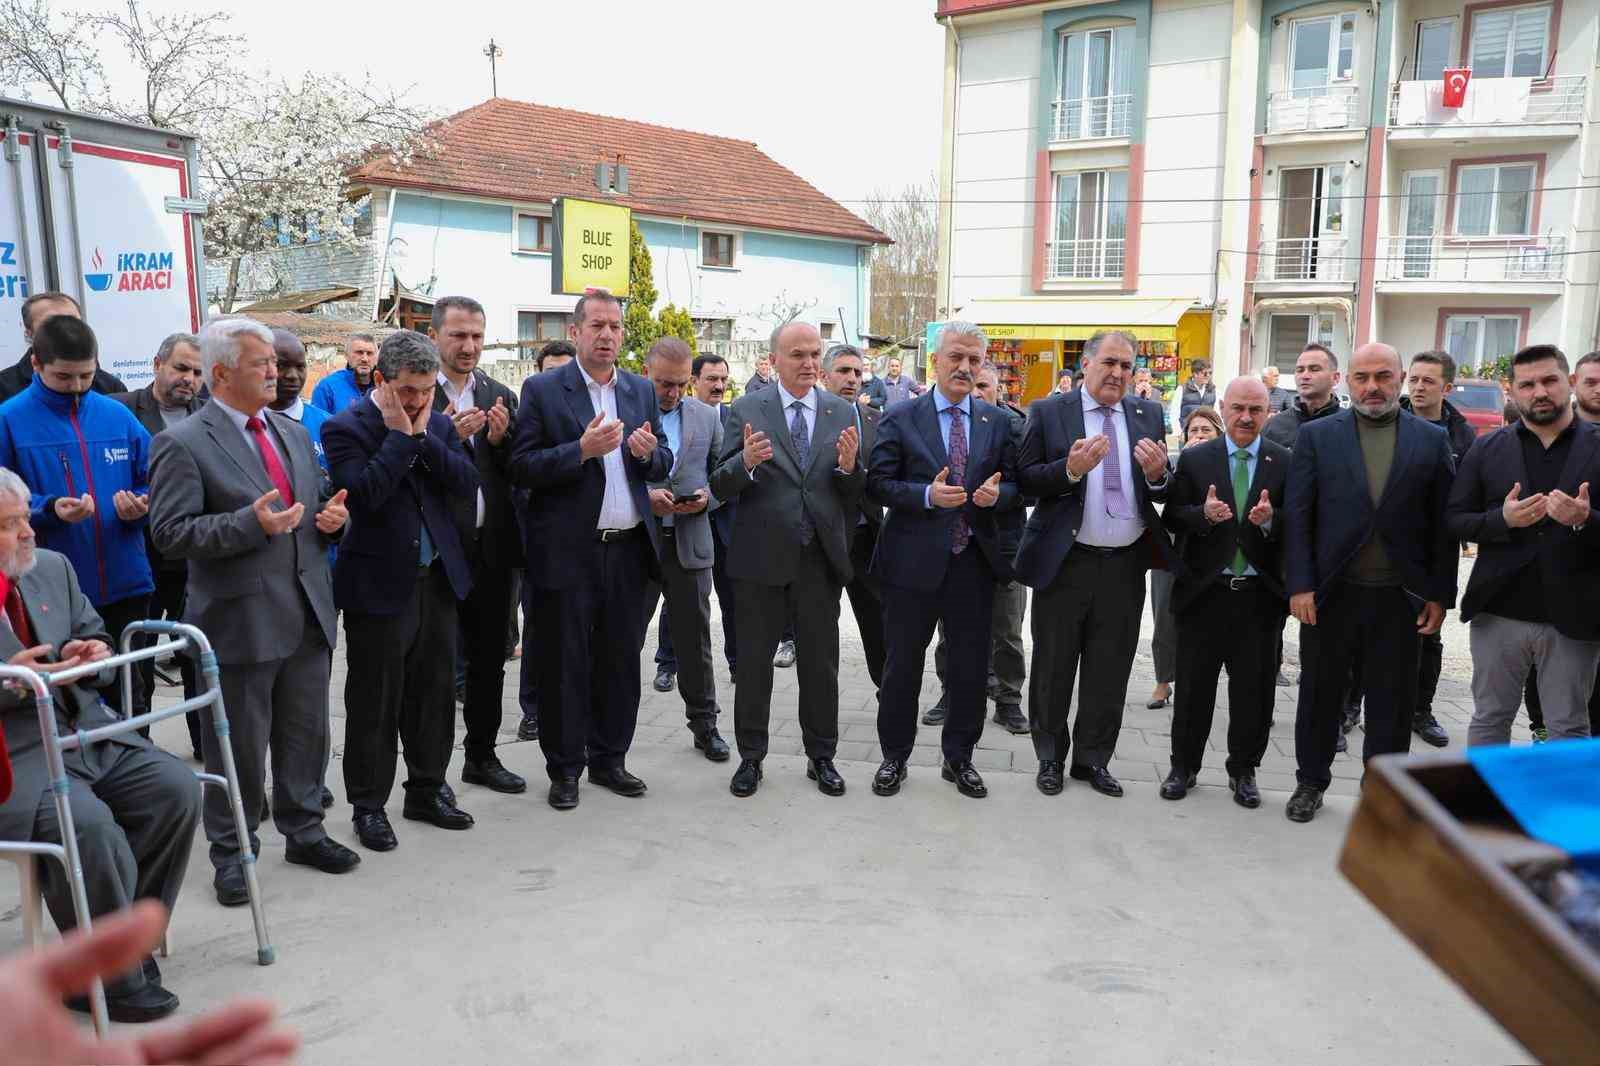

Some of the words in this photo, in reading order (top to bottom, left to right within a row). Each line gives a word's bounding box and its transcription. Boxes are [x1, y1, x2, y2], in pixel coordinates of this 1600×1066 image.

[583, 229, 613, 247] BLUE
[581, 254, 613, 270] SHOP
[117, 271, 172, 292] ARACI
[998, 327, 1015, 336] SHOP
